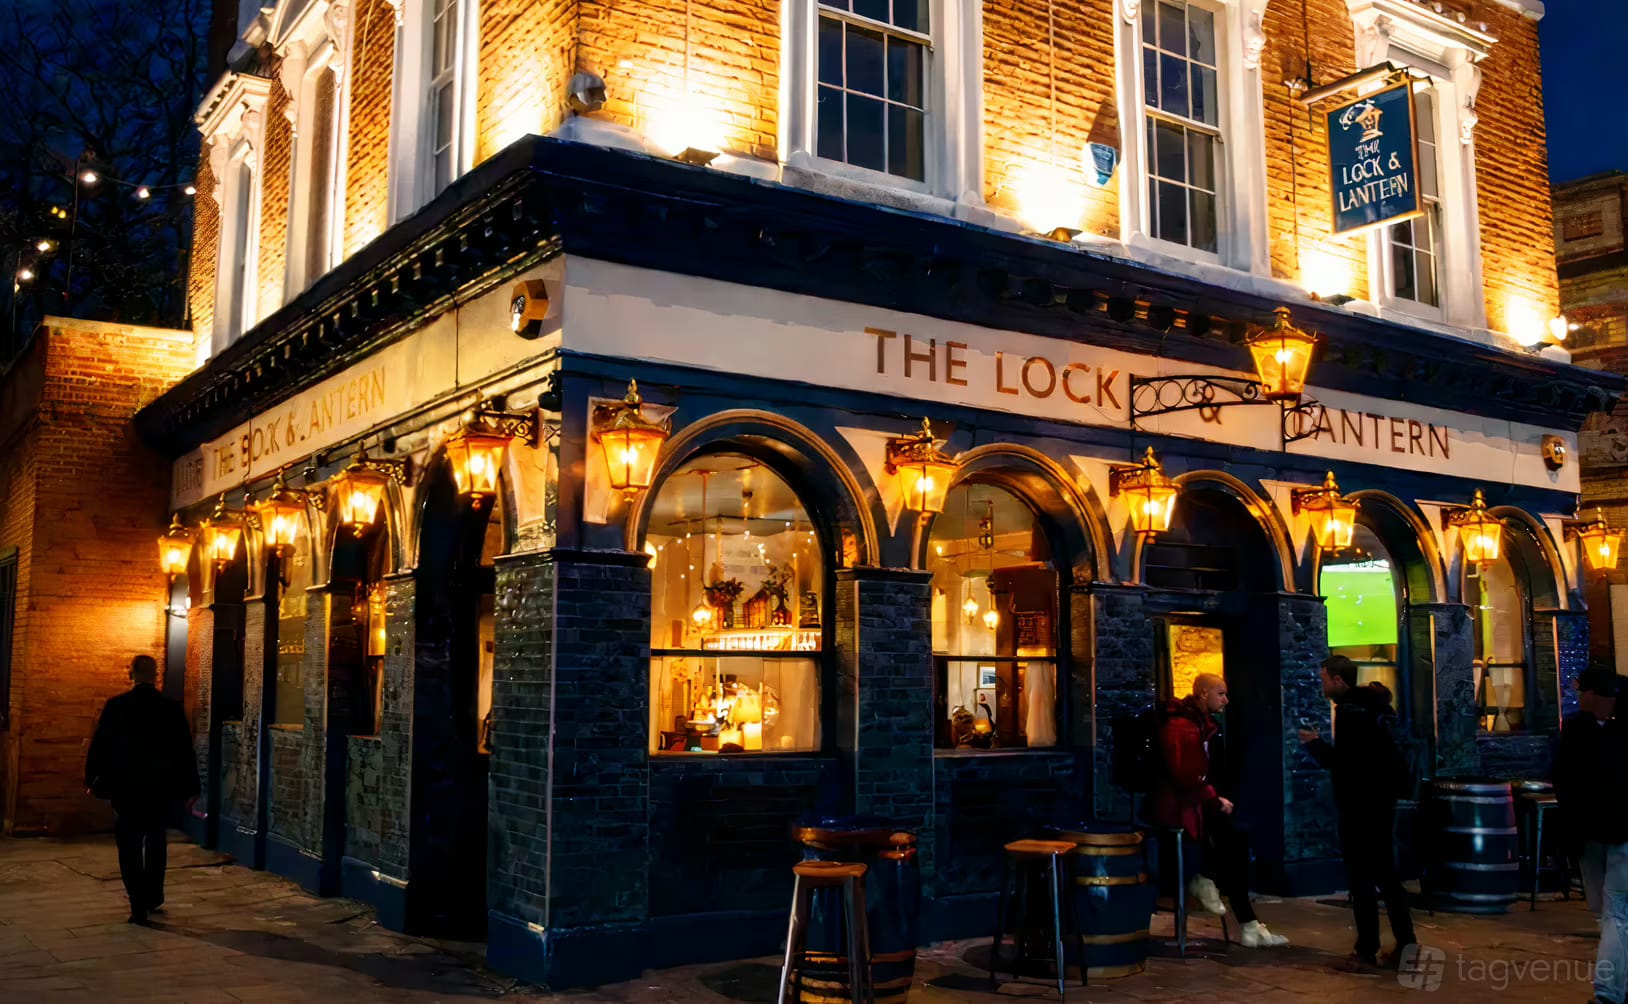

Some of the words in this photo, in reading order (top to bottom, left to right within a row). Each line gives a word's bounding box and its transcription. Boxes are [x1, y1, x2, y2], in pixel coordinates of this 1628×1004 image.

[1338, 172, 1408, 213] LANTERN
[1342, 155, 1384, 185] LOCK
[1388, 151, 1402, 171] &
[300, 365, 385, 442] ANTERN
[864, 326, 968, 387] THE
[996, 350, 1122, 410] LOCK
[1198, 382, 1222, 425] &
